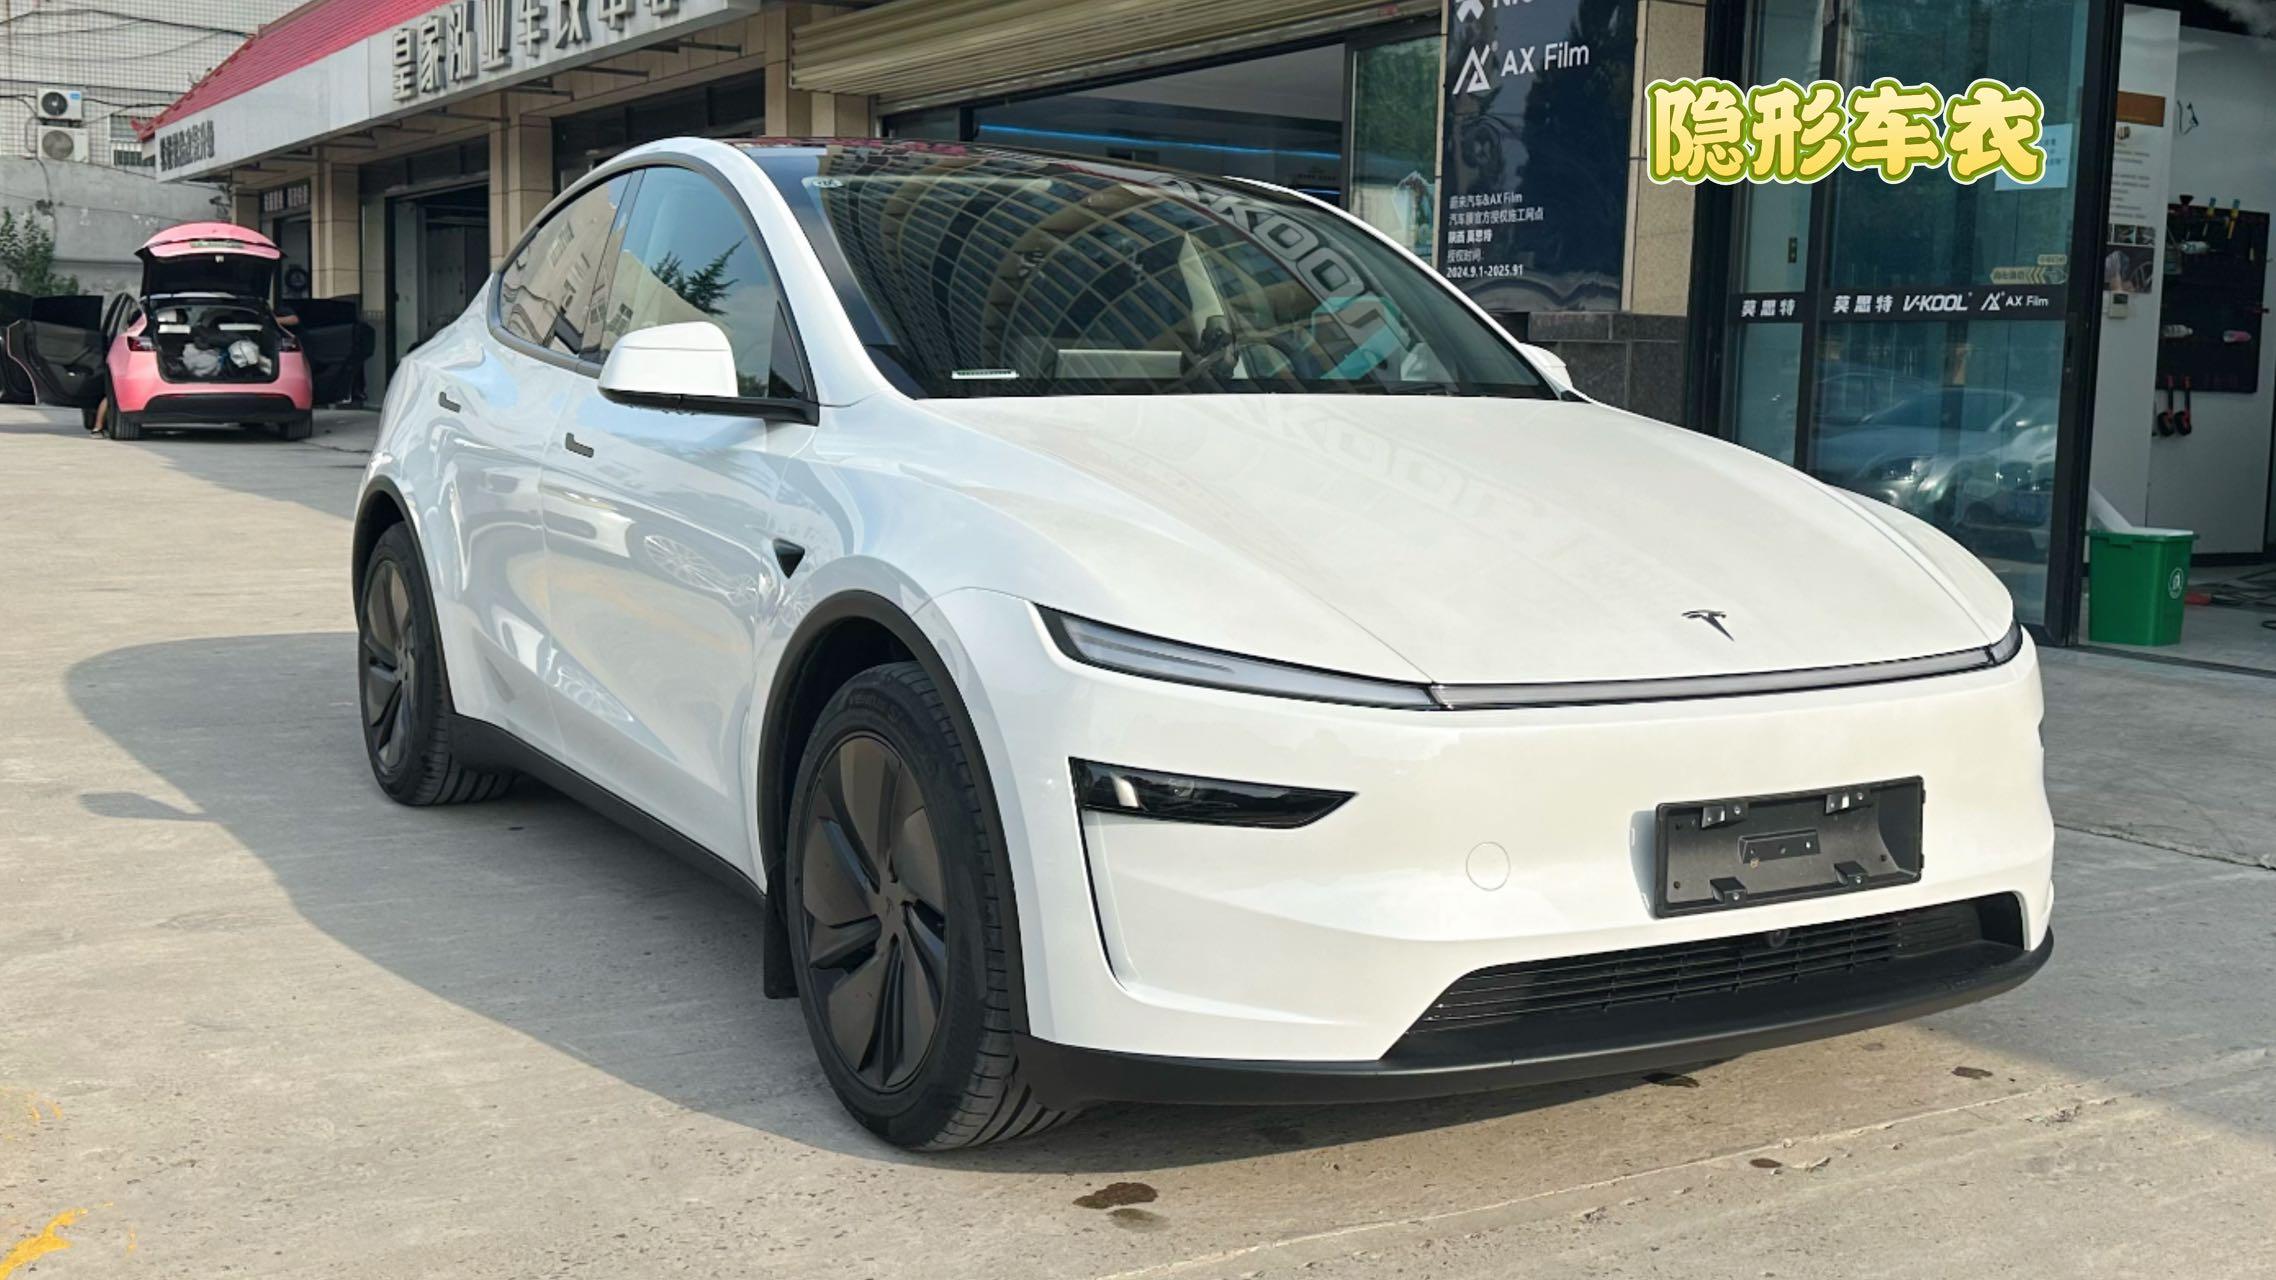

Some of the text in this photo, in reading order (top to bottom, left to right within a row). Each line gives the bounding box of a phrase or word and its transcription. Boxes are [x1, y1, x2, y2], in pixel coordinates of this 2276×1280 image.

[1501, 41, 1589, 77] AX Film
[1741, 299, 1796, 317] 莫思特
[1833, 295, 2049, 313] 莫思特 V-KOOL AX Film
